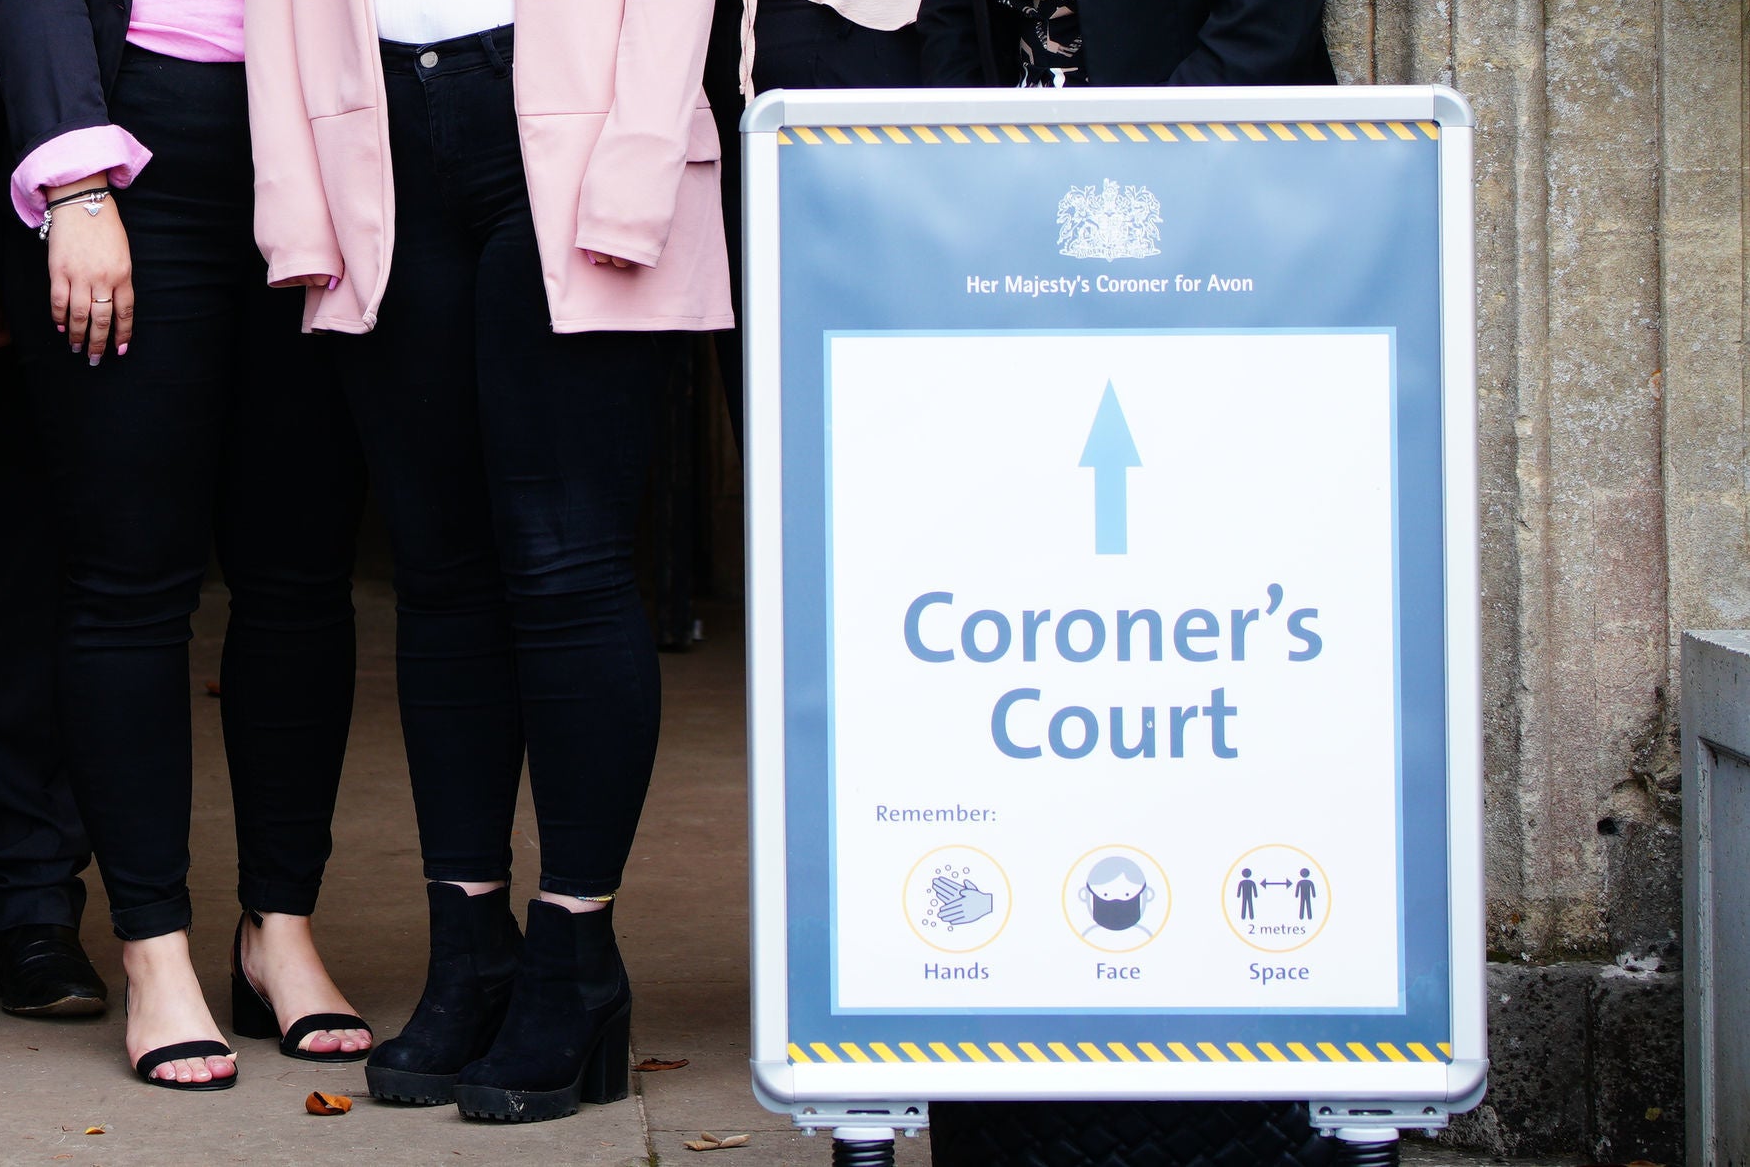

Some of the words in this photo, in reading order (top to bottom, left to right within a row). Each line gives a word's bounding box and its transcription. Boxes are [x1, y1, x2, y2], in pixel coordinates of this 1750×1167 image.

[966, 275, 998, 294] Her
[1005, 274, 1090, 297] Majesty's
[1096, 274, 1169, 293] Coroner
[1175, 274, 1202, 292] for
[1207, 274, 1253, 292] Avon
[903, 582, 1324, 664] Coroner's
[990, 686, 1239, 760] Court
[875, 803, 997, 823] Remember:
[1247, 924, 1256, 936] 2
[1259, 923, 1307, 936] metres
[923, 961, 990, 982] Hands
[1095, 962, 1141, 982] Face
[1248, 961, 1310, 986] Space
